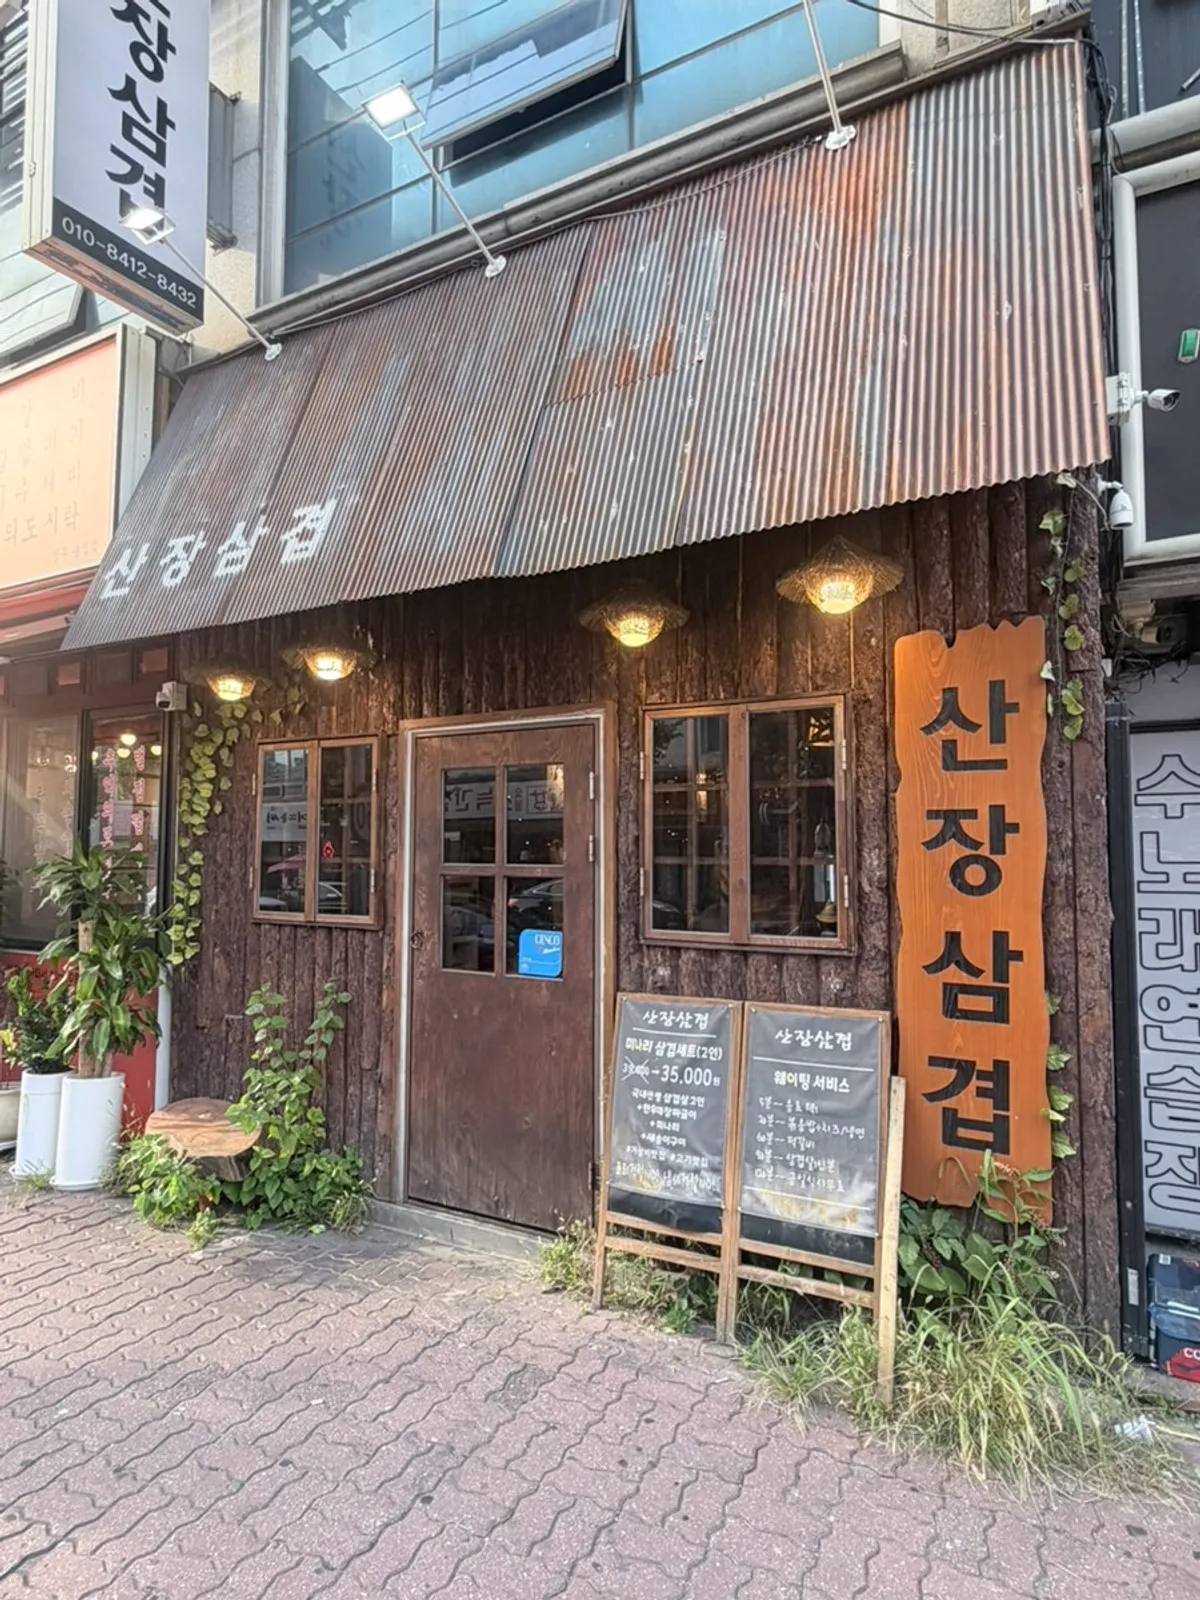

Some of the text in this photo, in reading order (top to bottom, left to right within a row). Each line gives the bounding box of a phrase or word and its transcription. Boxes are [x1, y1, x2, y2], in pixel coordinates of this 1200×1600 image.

[105, 0, 177, 219] 장삼겹
[62, 217, 197, 308] 010-8412-8432
[100, 498, 337, 599] 산장삼겹
[920, 679, 1023, 1155] 산장삼겹
[642, 1009, 709, 1030] 산장삼겹
[625, 1037, 723, 1061] 미나리 삼겹세트(2인)
[775, 1028, 852, 1051] 산장삼겹
[774, 1070, 850, 1093] 웨이팅 서비스
[663, 1092, 690, 1106] 삼겹살
[691, 1095, 706, 1108] 2인
